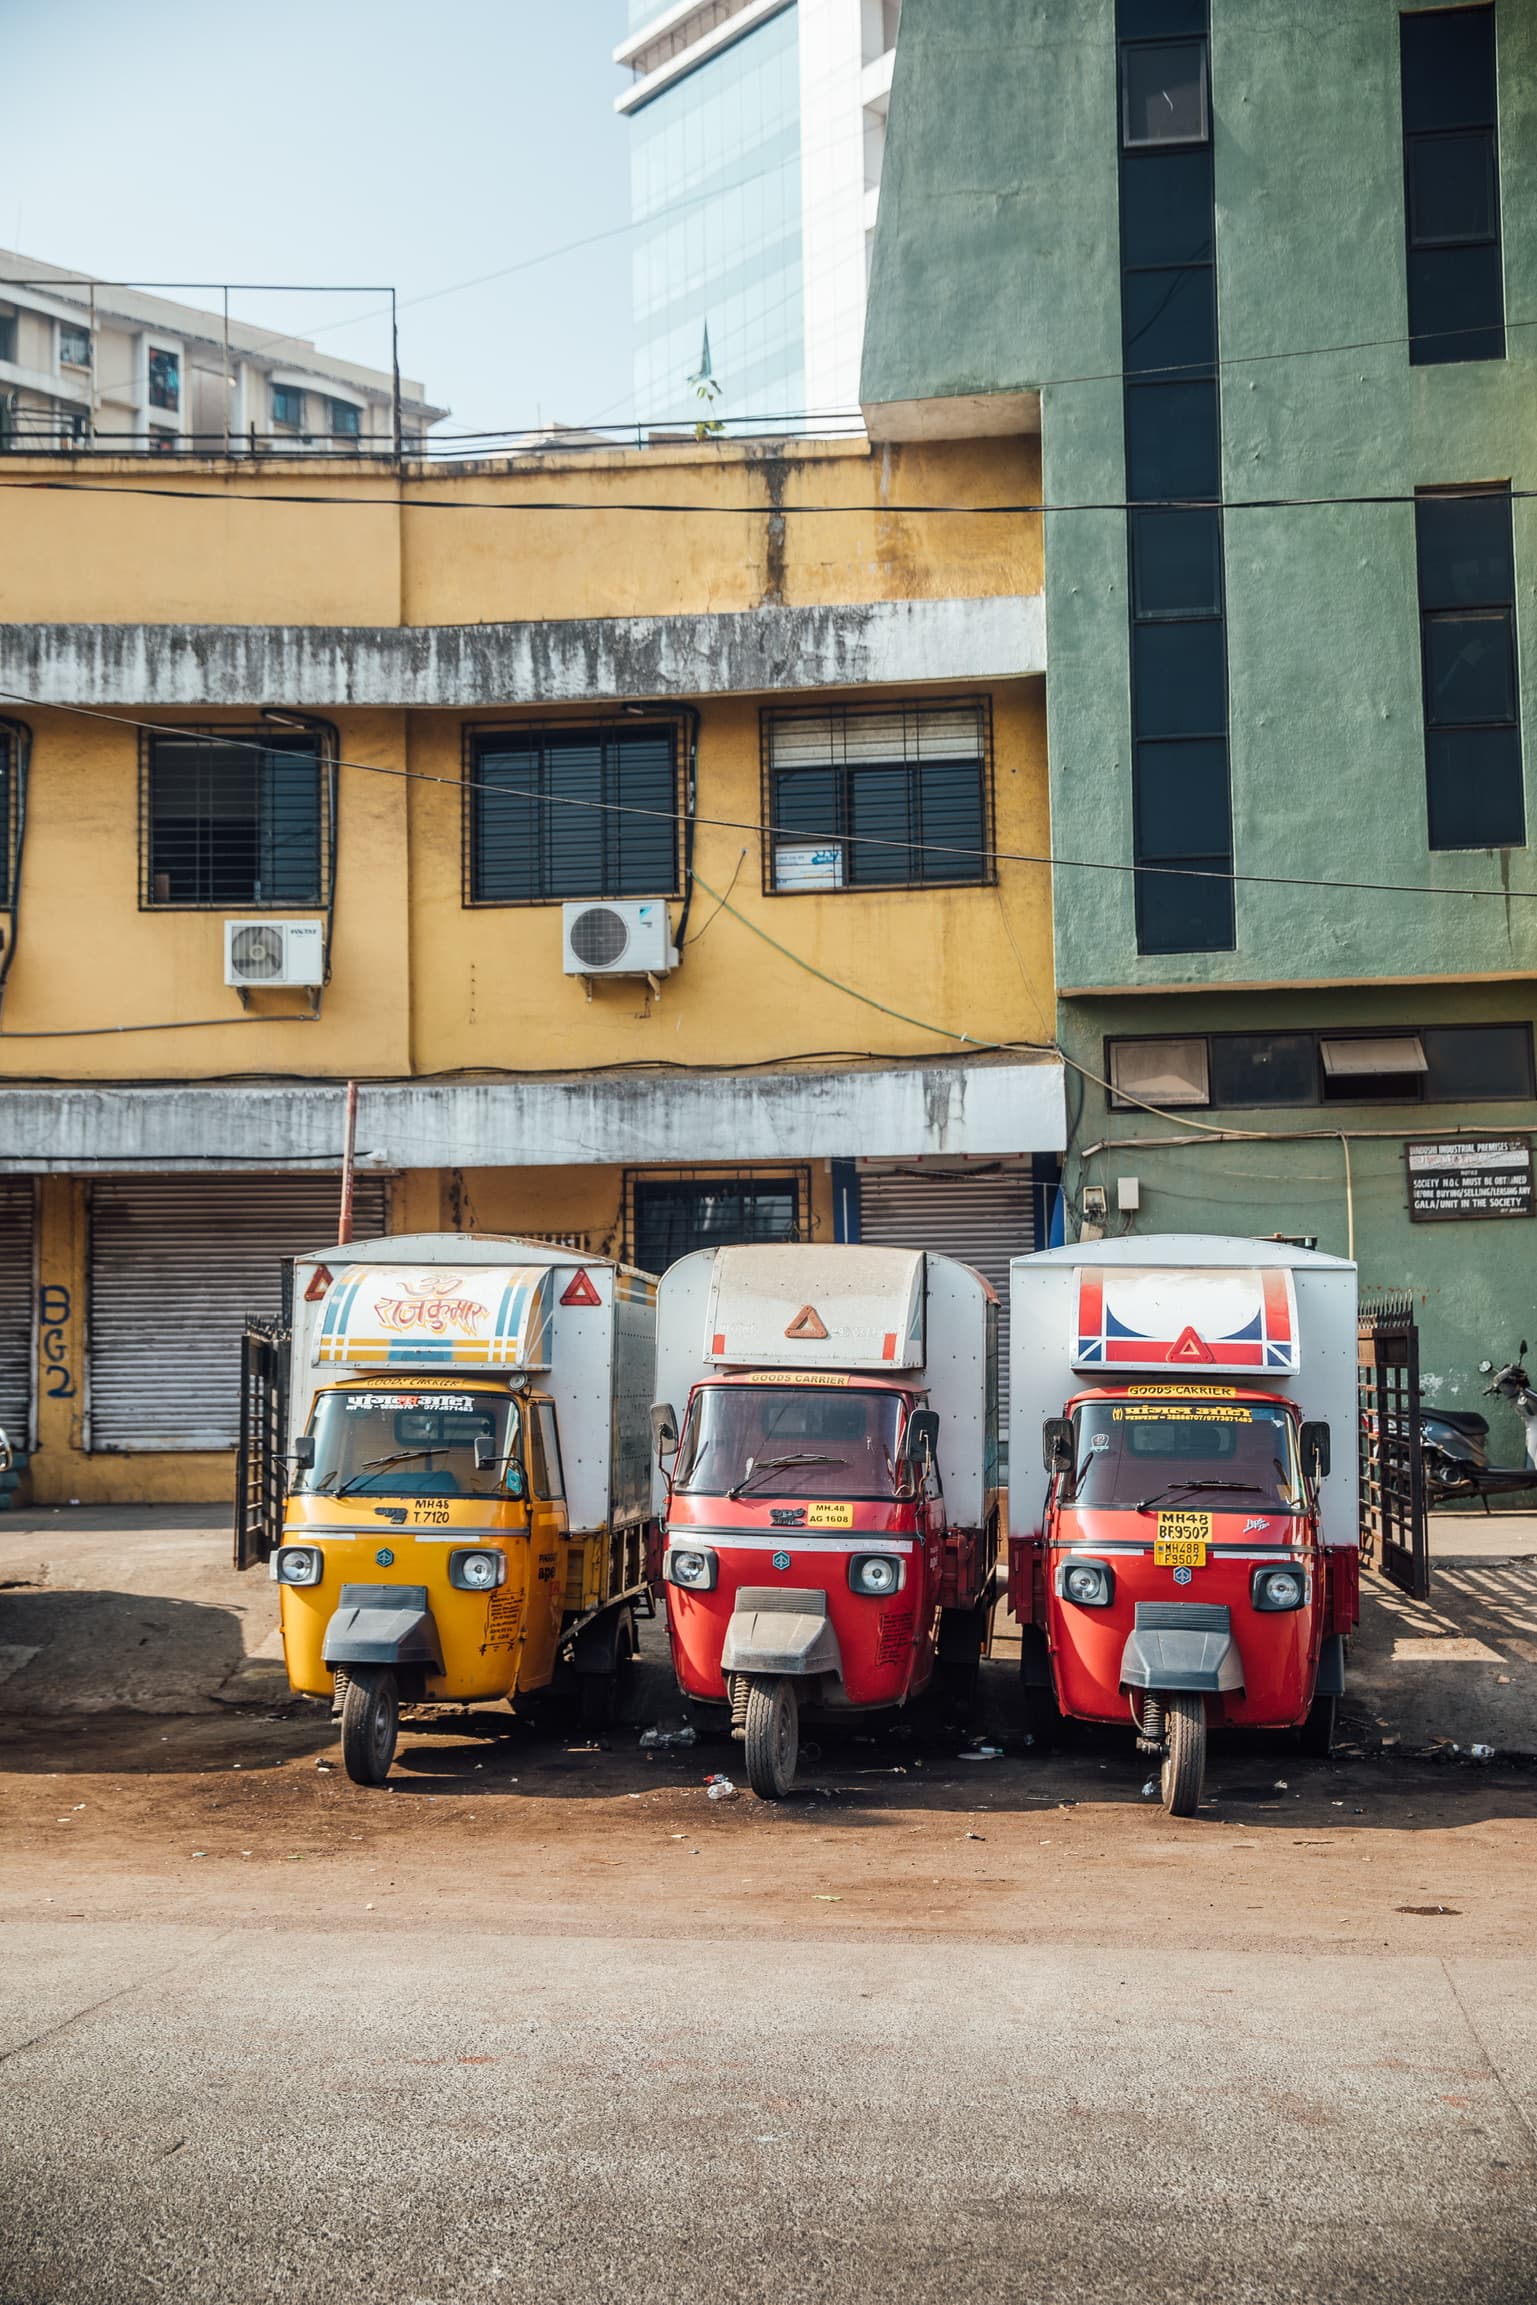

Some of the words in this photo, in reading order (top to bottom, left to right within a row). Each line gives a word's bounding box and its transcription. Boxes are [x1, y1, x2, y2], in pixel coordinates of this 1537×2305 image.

[1439, 1144, 1475, 1154] INDUSTRIAL
[1477, 1142, 1509, 1152] PREMISES
[1413, 1179, 1439, 1188] SOCIETY
[1462, 1177, 1481, 1186] MUST
[1484, 1176, 1493, 1185] BE
[1519, 1186, 1531, 1195] ANY
[1414, 1199, 1458, 1210] GALA/UNIT
[1461, 1200, 1470, 1208] IN
[1472, 1199, 1487, 1207] THE
[1490, 1198, 1522, 1207] SOCIETY
[751, 1373, 792, 1382] GOODS
[795, 1373, 845, 1385] CARRIER
[826, 1515, 849, 1523] 1608
[1162, 1513, 1209, 1525] MH48
[1165, 1554, 1199, 1565] F9507
